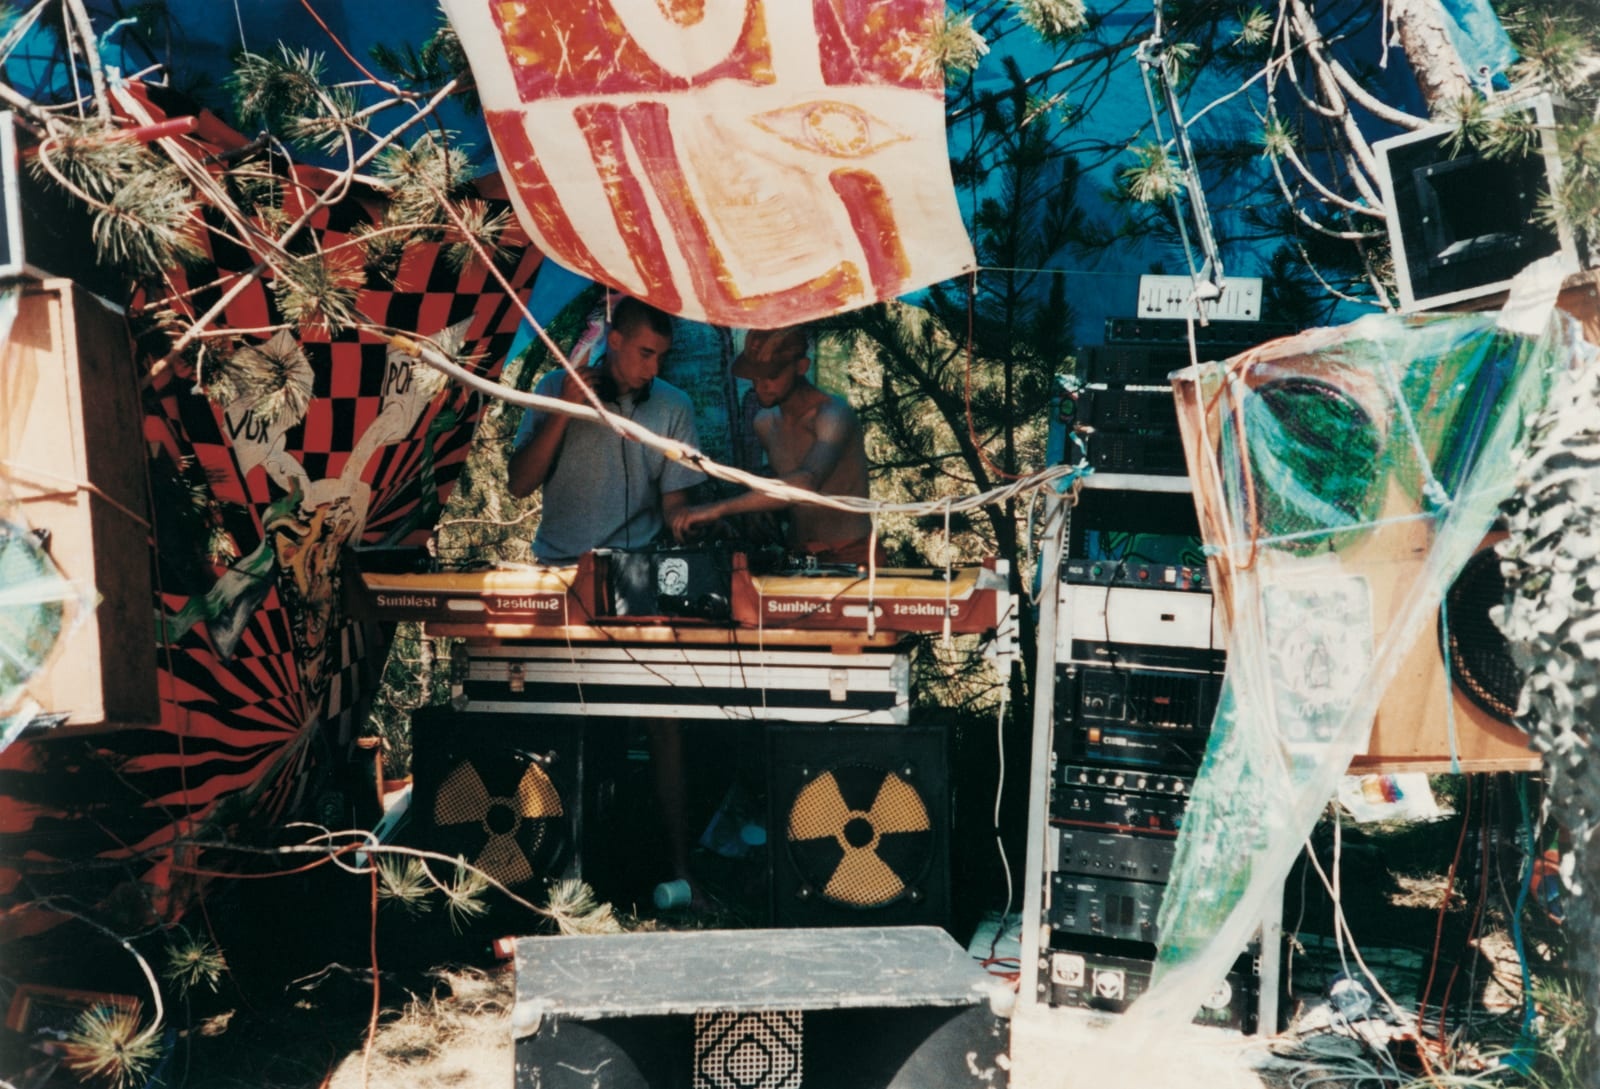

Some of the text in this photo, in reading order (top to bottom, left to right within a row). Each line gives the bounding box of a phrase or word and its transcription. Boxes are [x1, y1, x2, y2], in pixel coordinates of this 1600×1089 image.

[224, 408, 271, 444] VOX
[376, 594, 437, 607] Sunblest
[767, 600, 832, 614] Sunblest
